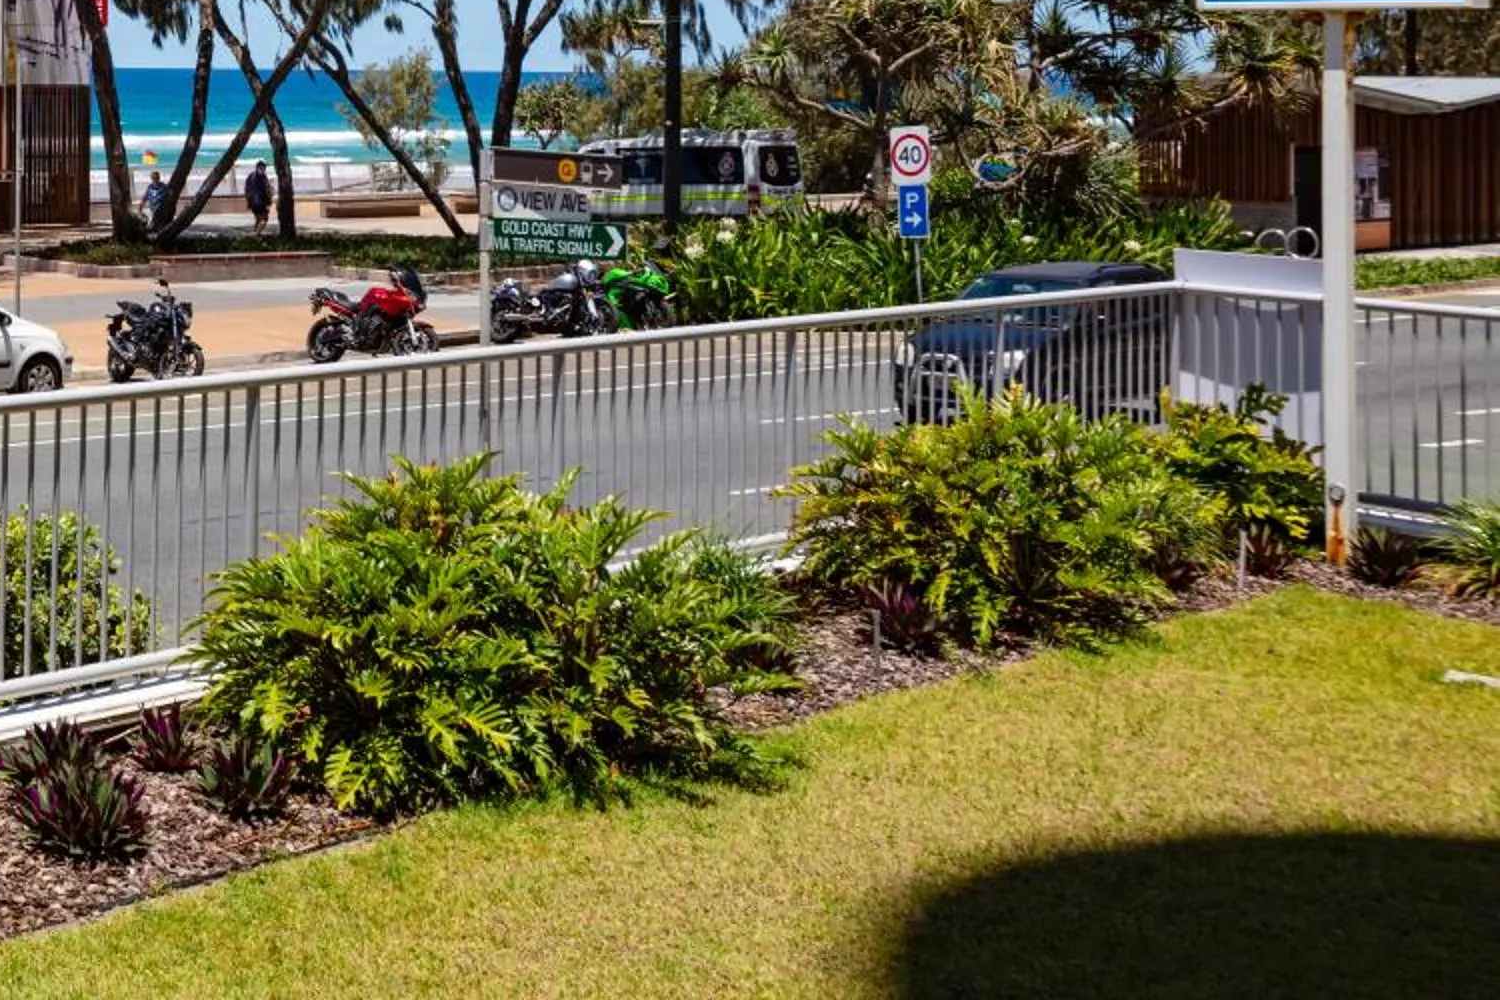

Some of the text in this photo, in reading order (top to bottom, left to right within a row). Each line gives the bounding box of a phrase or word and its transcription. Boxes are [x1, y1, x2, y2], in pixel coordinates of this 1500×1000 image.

[898, 145, 922, 165] 40
[521, 191, 588, 213] VIEW AVE
[905, 191, 920, 209] P
[501, 220, 595, 239] GOLD COAST HWY
[512, 238, 555, 253] TRAFFIC
[557, 240, 603, 257] SIGNALS
